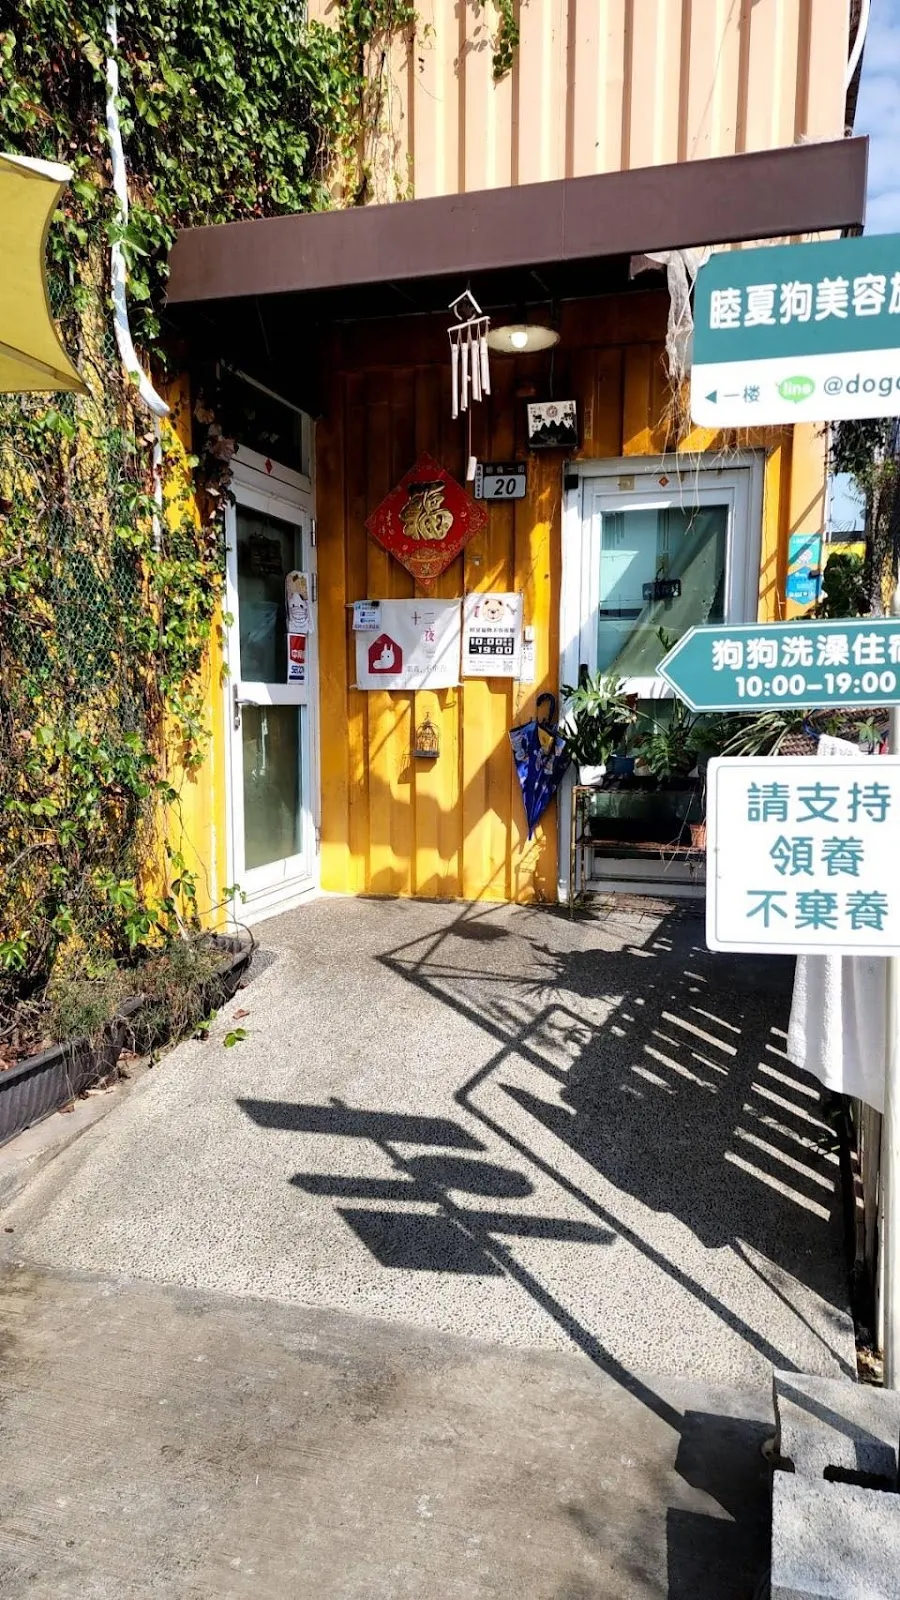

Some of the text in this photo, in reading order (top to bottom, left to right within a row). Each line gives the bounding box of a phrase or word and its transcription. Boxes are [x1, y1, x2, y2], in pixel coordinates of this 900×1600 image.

[494, 478, 516, 496] 20
[399, 480, 453, 540] 福
[747, 782, 891, 822] 請支持
[769, 834, 864, 877] 領養
[746, 889, 889, 931] 不棄養
